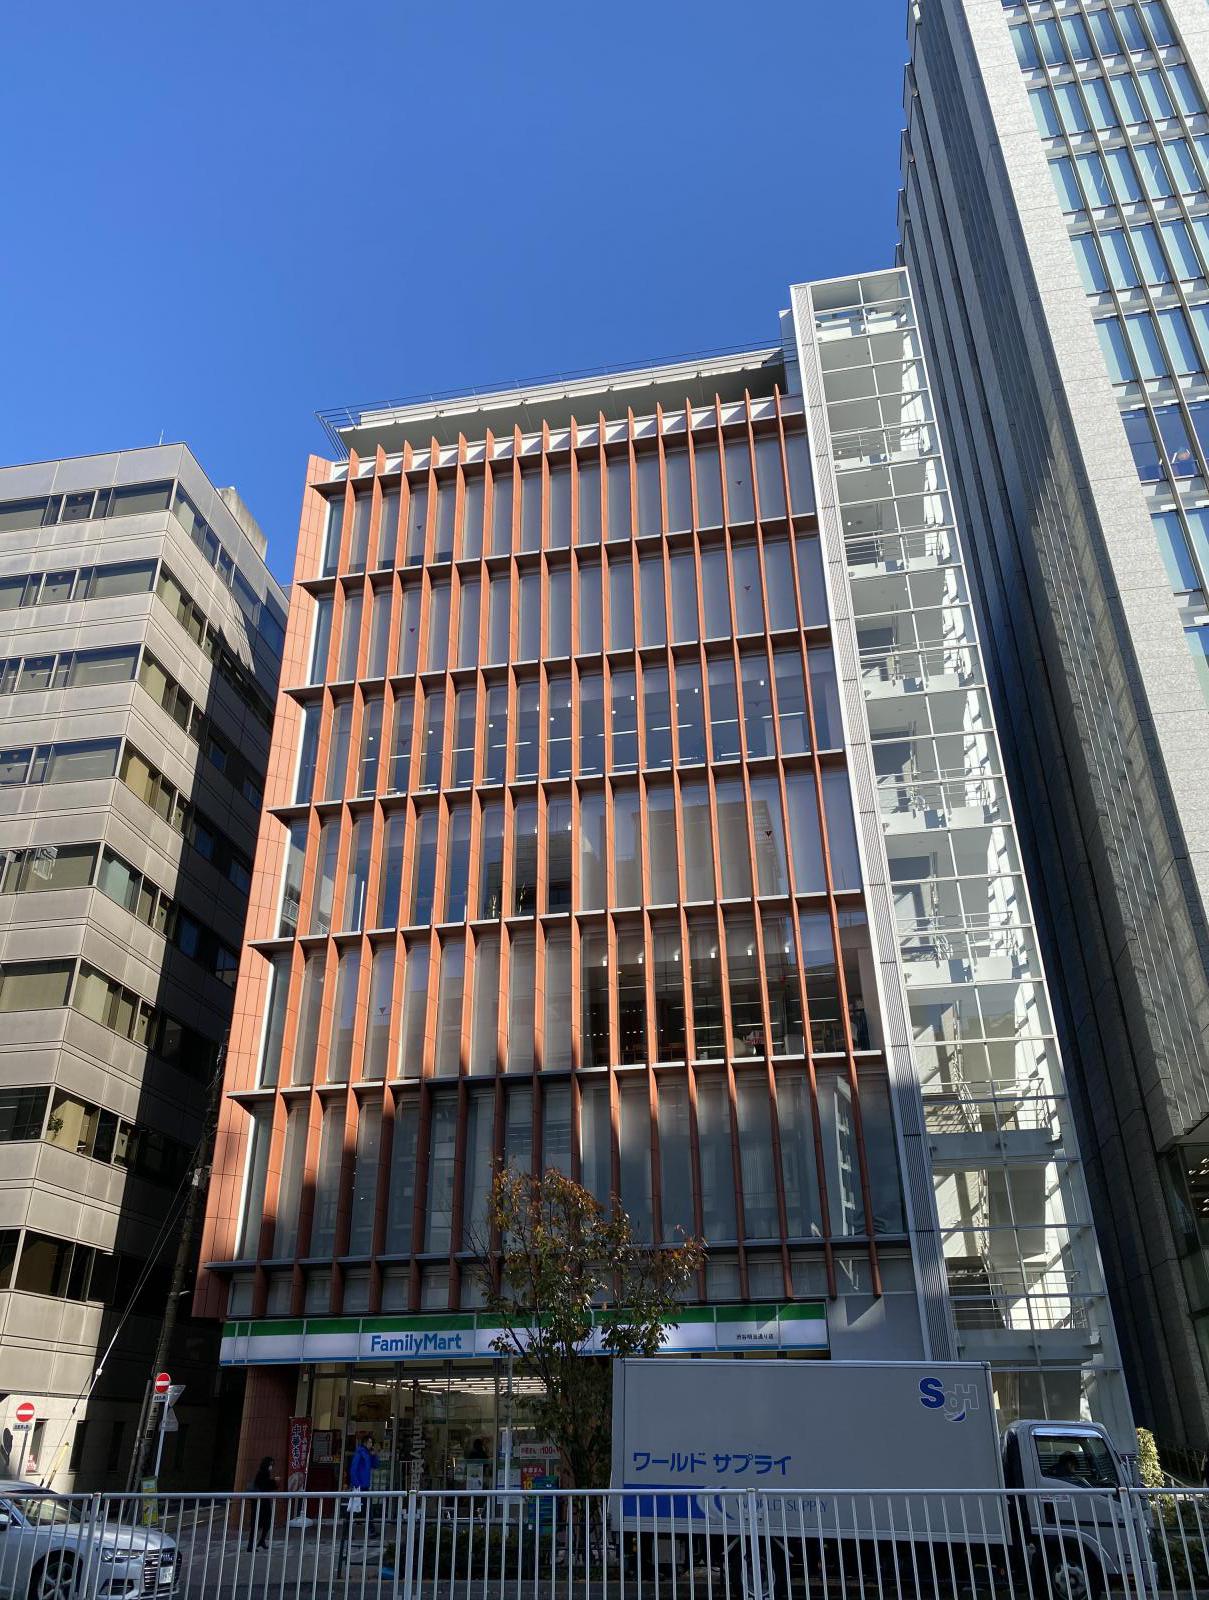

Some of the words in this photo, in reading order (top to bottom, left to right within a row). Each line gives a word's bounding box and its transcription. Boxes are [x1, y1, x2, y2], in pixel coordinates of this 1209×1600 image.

[371, 1333, 462, 1356] FamilyMart
[633, 1452, 707, 1473] ワールド
[712, 1453, 792, 1475] サプライ
